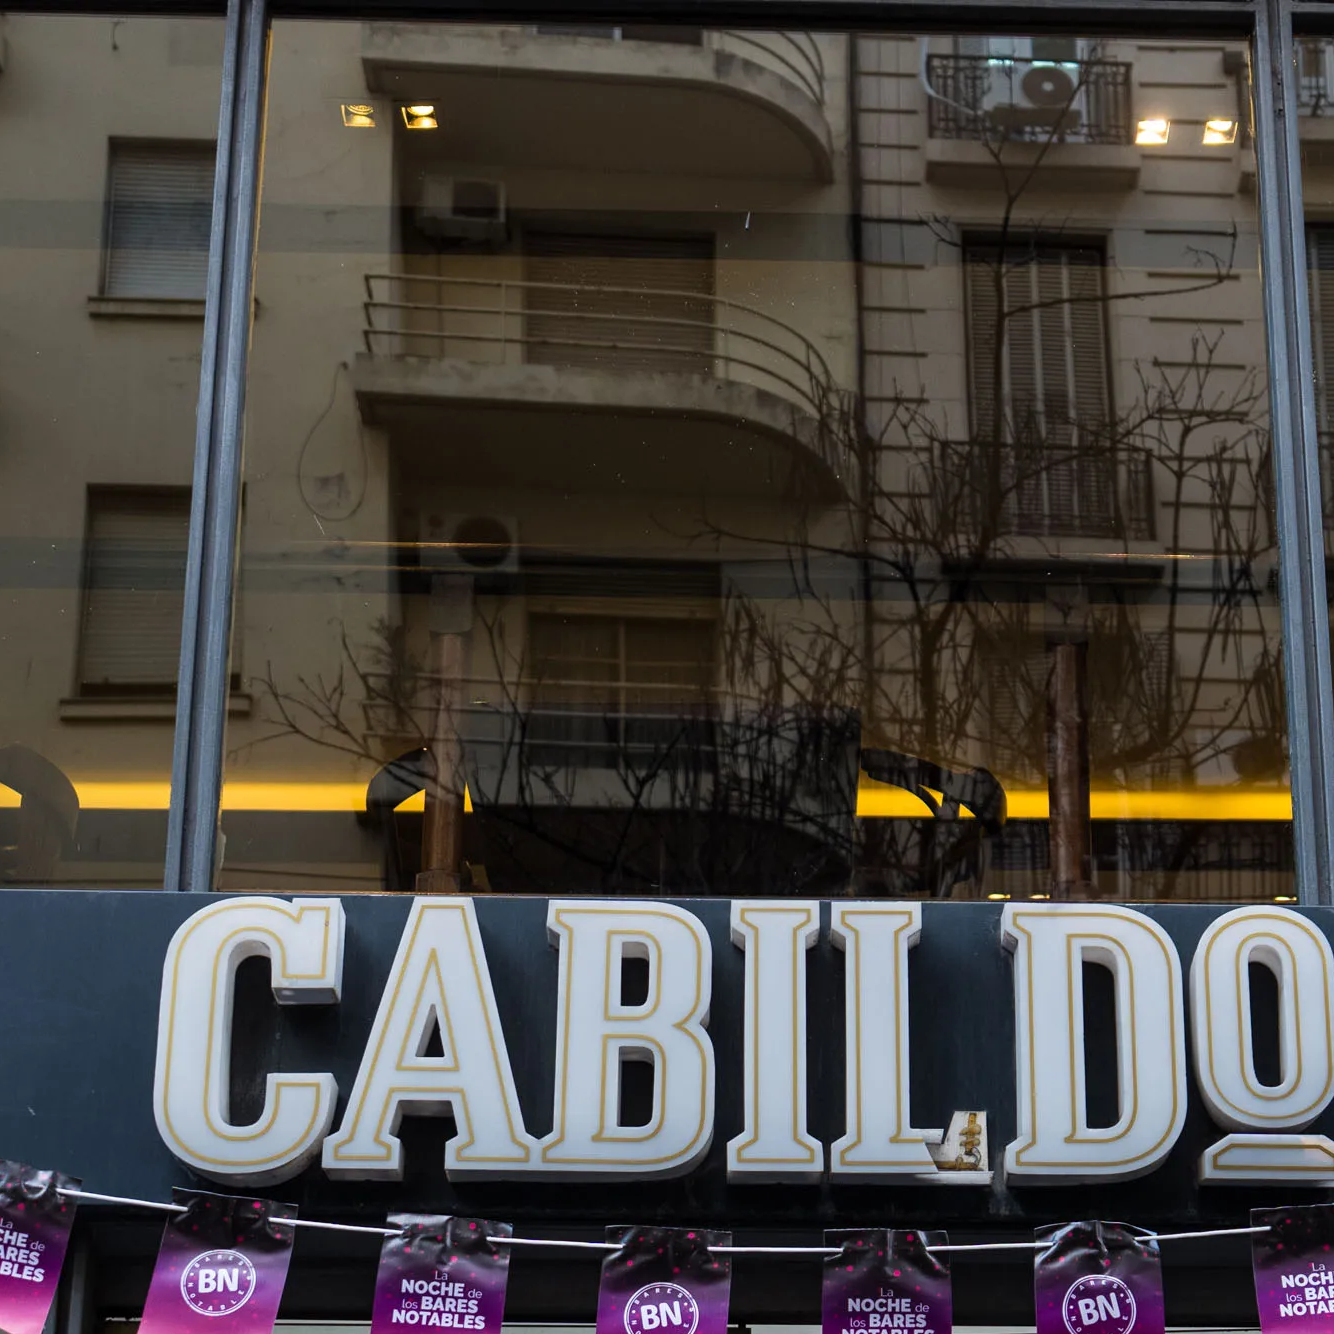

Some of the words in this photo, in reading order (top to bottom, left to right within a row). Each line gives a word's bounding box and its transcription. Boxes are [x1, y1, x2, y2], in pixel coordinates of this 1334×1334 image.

[197, 1268, 240, 1293] BN
[434, 1271, 448, 1281] La
[401, 1279, 464, 1297] NOCHE
[467, 1288, 483, 1299] de
[401, 1298, 418, 1310] los
[420, 1296, 478, 1314] BARES
[1078, 1294, 1120, 1326] BN
[391, 1310, 486, 1330] NOTABLES
[640, 1301, 682, 1331] BN
